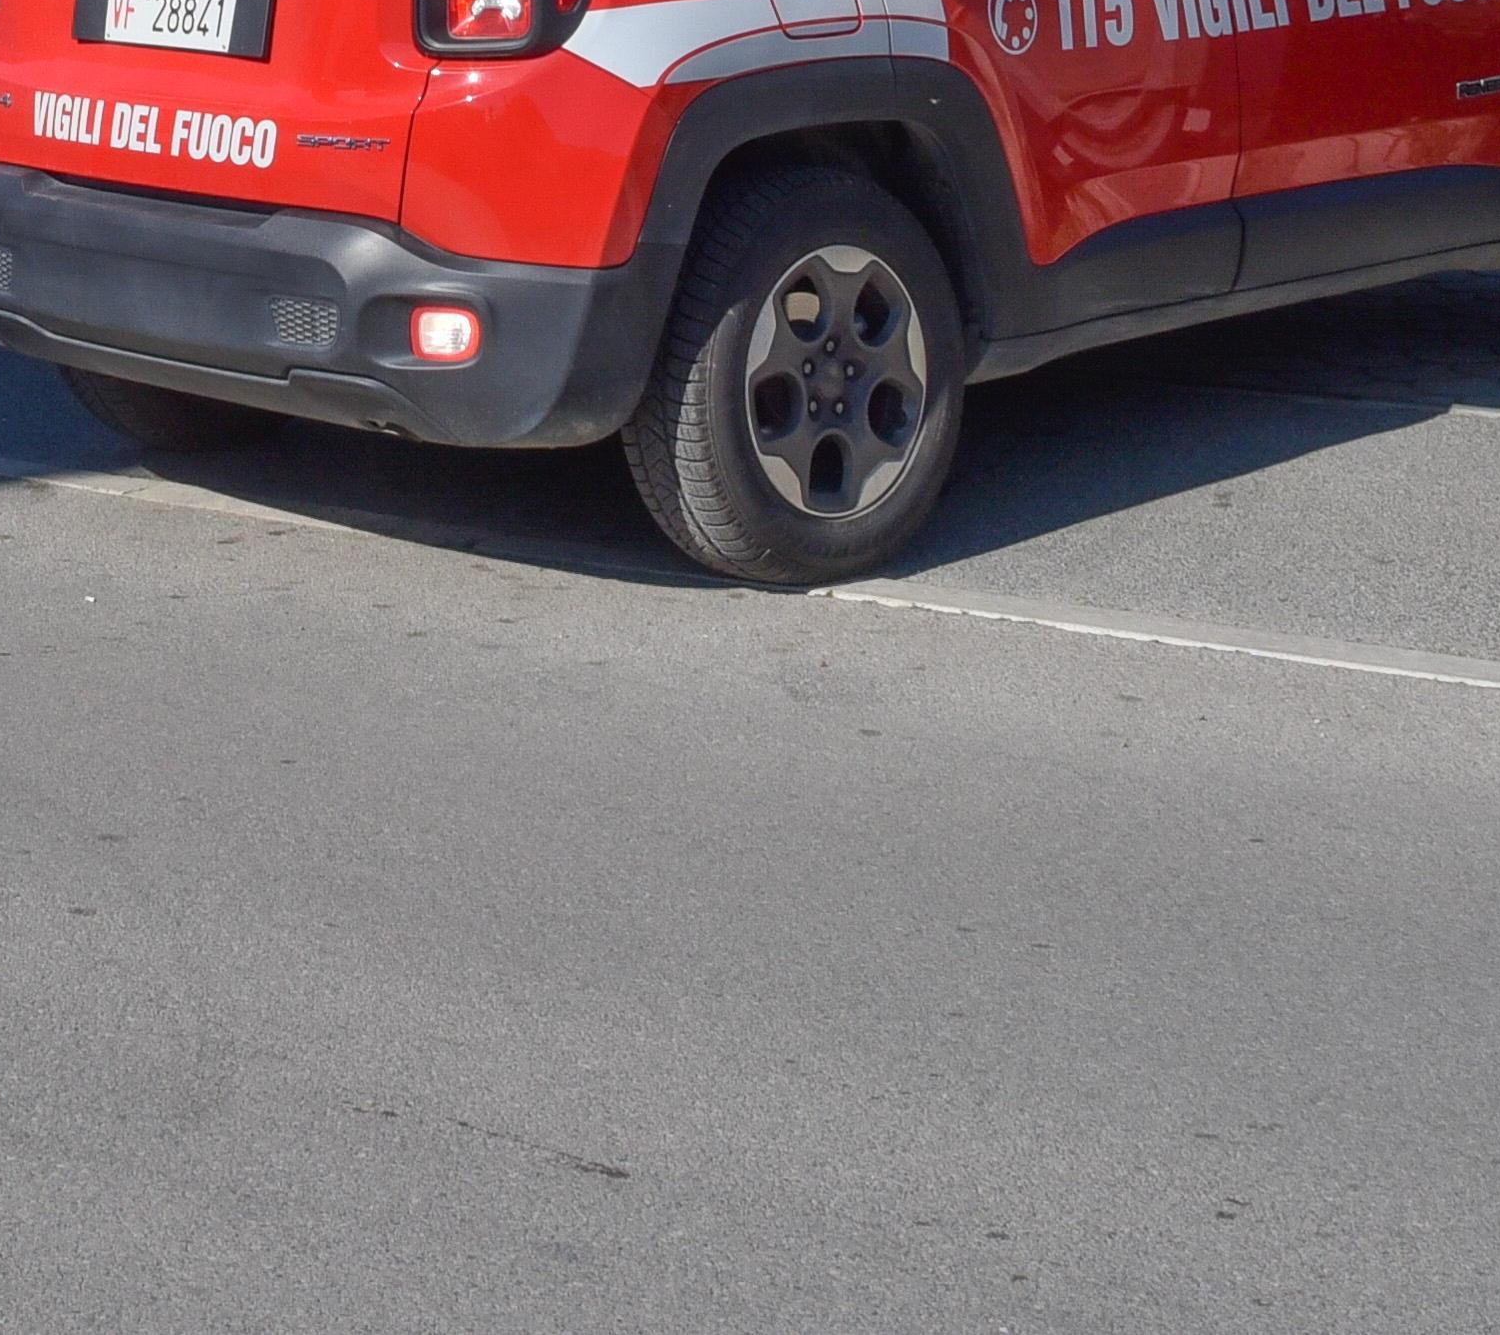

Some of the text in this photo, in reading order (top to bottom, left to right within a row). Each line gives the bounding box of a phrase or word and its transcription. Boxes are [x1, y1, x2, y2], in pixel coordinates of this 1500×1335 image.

[33, 90, 277, 169] VIGILI DEL FUOCO
[297, 134, 391, 152] SPORT
